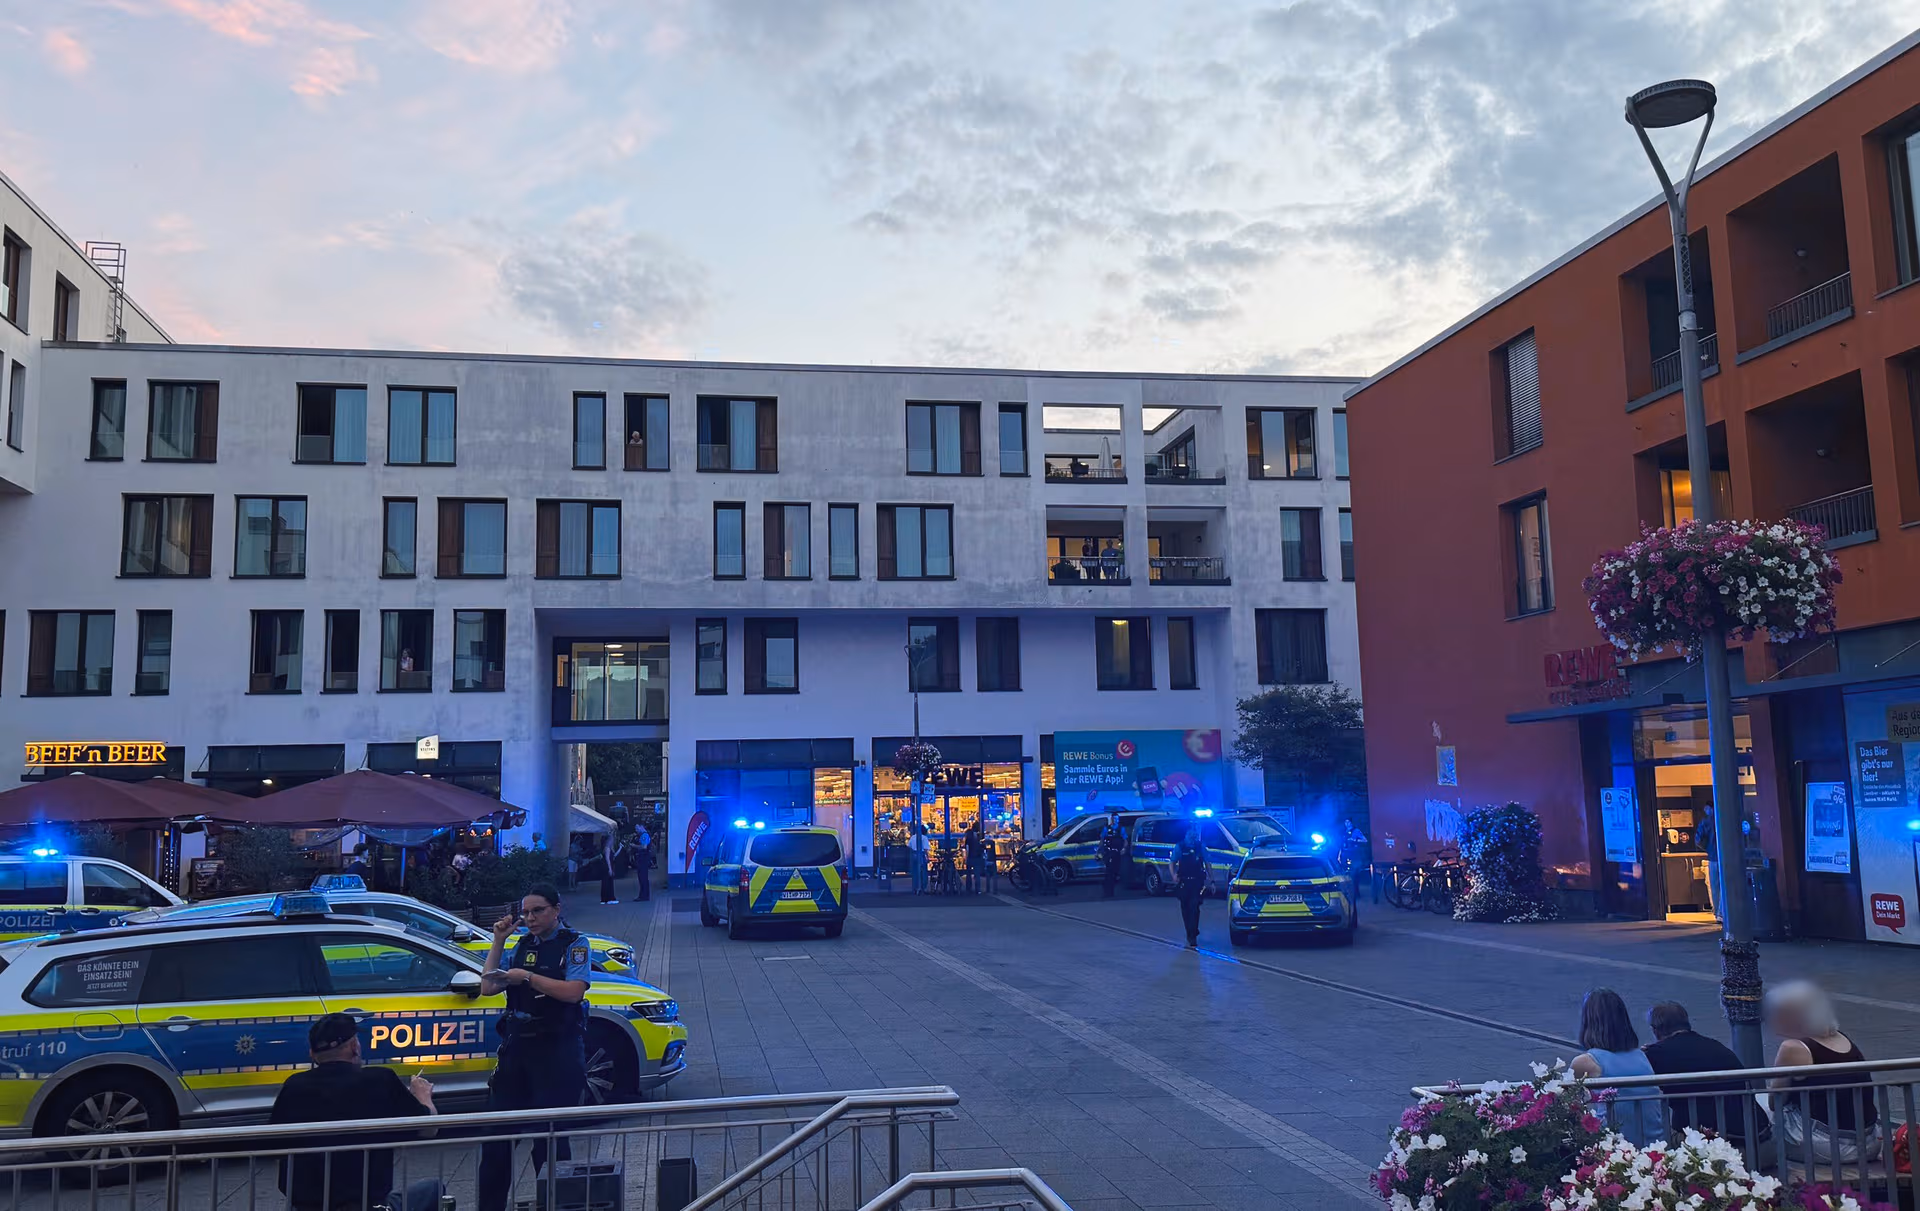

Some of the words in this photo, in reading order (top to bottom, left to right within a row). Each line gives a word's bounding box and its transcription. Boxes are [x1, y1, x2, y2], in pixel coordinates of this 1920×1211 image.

[1544, 643, 1618, 687] REWE
[1892, 710, 1908, 721] Aus
[108, 744, 167, 762] BEER
[1063, 752, 1088, 761] REWE
[1090, 752, 1114, 760] Bonus
[1860, 747, 1873, 757] Das
[1874, 746, 1889, 756] Bier
[1063, 765, 1096, 774] Sammle
[1096, 765, 1119, 773] Euros
[1120, 764, 1128, 773] in
[1861, 759, 1880, 772] gibt's
[1881, 760, 1894, 769] nur
[1064, 776, 1077, 784] der
[1078, 775, 1104, 784] REWE
[1105, 775, 1124, 785] App!
[1862, 771, 1879, 782] hier!
[688, 821, 708, 850] REWE
[1875, 900, 1900, 911] REWE
[77, 964, 92, 972] DAS
[93, 960, 121, 971] KÖNNTE
[122, 961, 139, 970] DEIN
[83, 971, 112, 981] EINSATZ
[113, 970, 132, 979] SEIN!
[370, 1019, 485, 1049] POLIZEI
[0, 1043, 31, 1059] truf
[38, 1041, 67, 1056] 110
